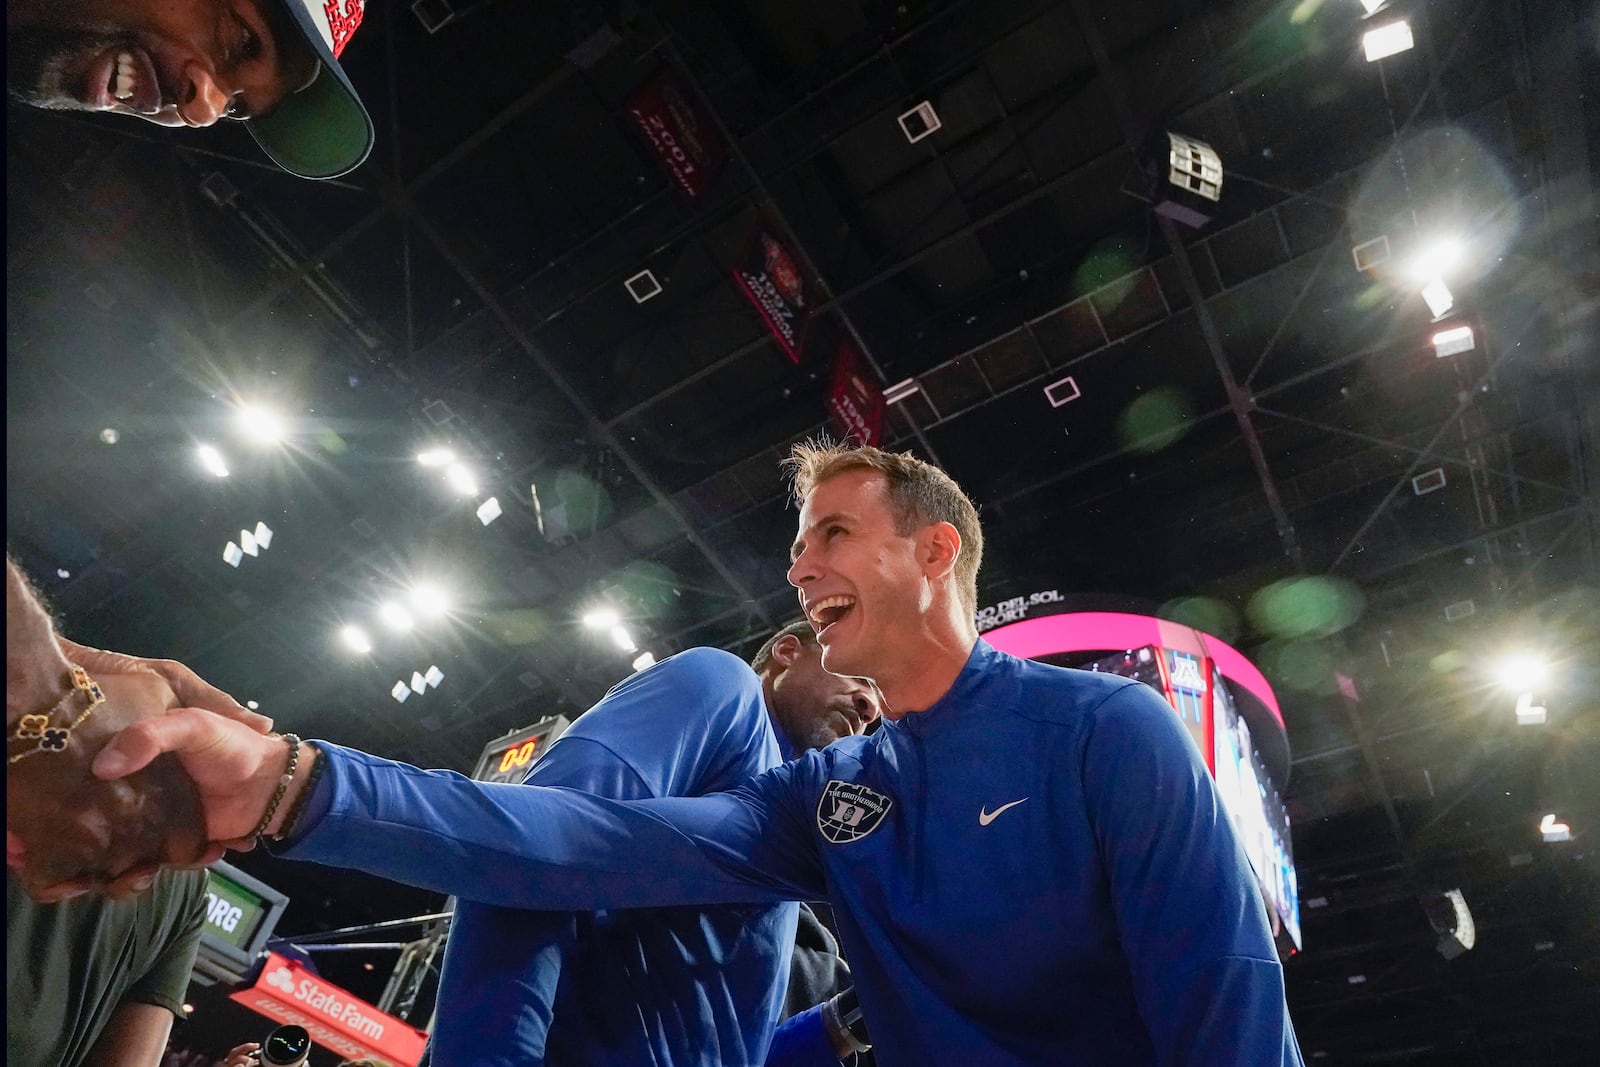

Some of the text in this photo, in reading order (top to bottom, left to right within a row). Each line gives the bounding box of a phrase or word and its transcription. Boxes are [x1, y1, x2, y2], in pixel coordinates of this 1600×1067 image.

[648, 113, 695, 174] 2001
[997, 596, 1030, 615] DEL
[1029, 590, 1064, 606] SOL
[828, 790, 884, 814] THE BROTHERHOOD
